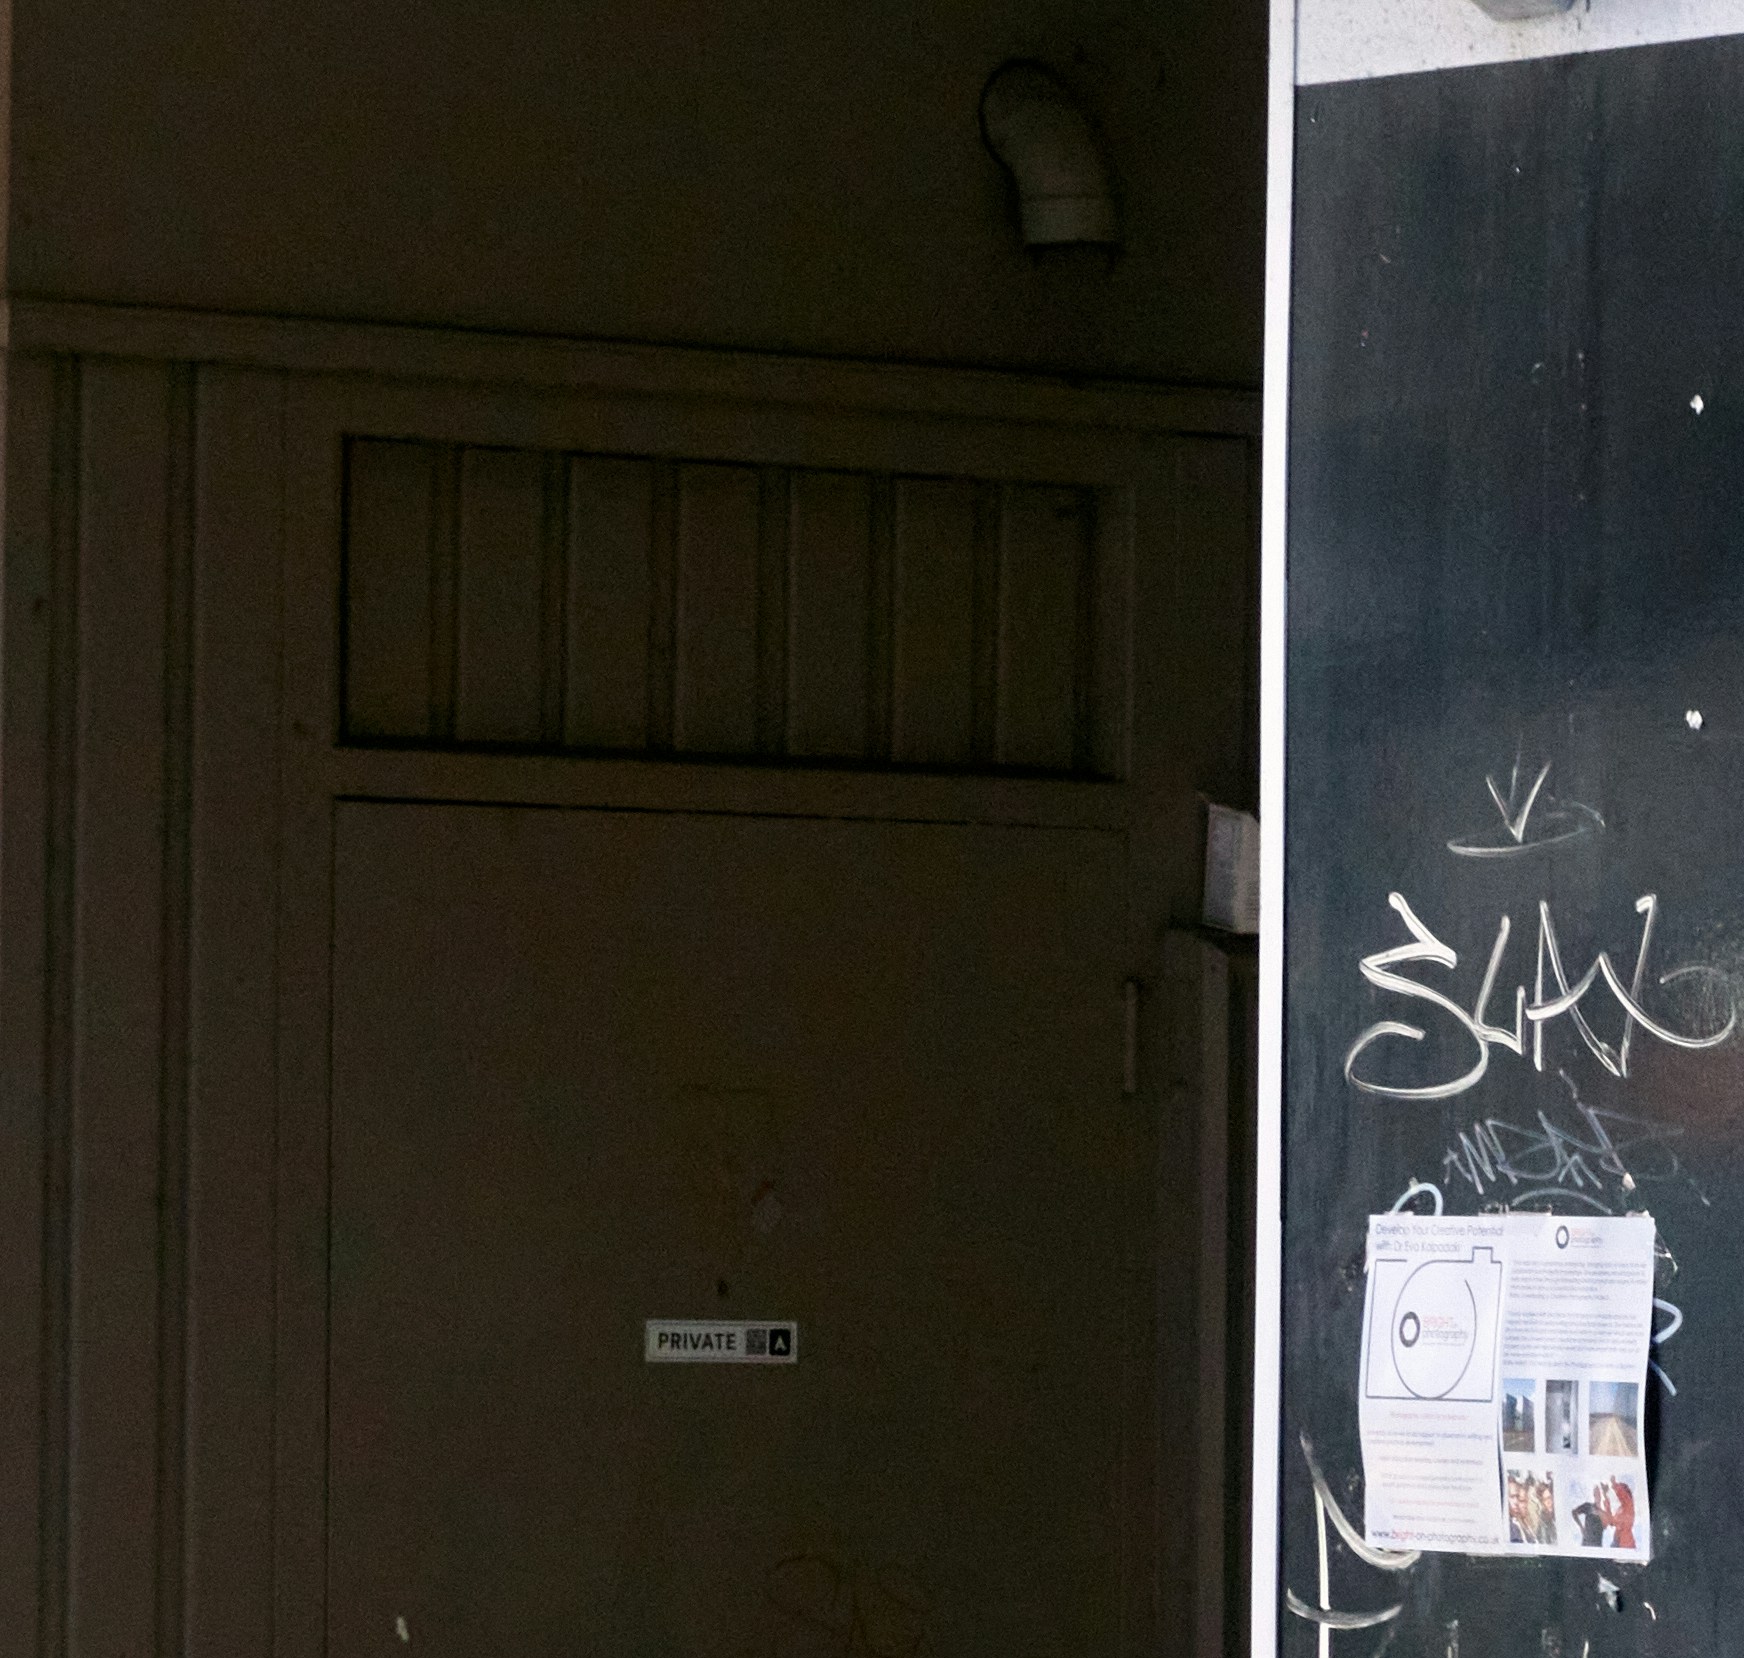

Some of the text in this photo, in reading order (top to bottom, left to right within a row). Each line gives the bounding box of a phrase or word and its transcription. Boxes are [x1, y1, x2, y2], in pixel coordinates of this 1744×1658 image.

[1411, 1224, 1429, 1236] Your
[1431, 1224, 1465, 1236] Creative
[657, 1332, 737, 1351] PRIVATE
